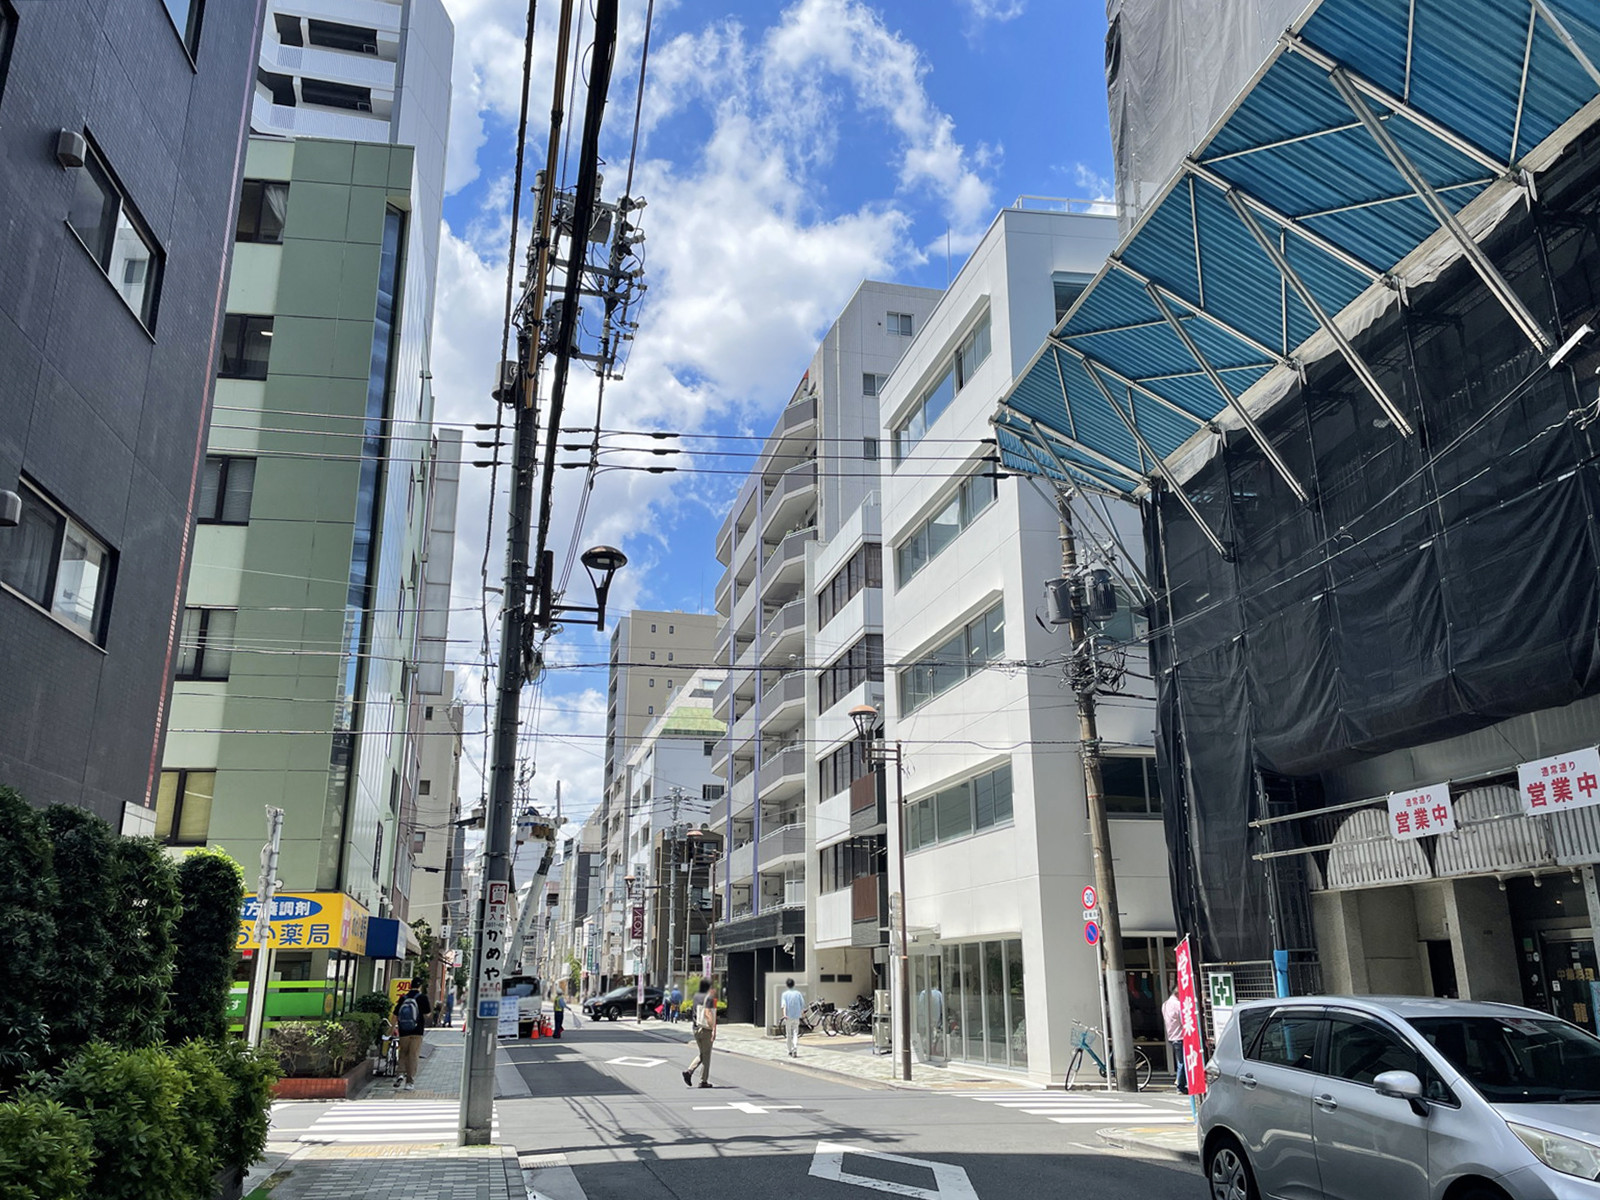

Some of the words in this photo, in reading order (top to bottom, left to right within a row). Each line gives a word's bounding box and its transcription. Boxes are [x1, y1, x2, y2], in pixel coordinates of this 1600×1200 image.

[1540, 761, 1576, 777] 通常通り
[1527, 772, 1599, 808] 営業中
[1396, 804, 1448, 834] 営業中
[1085, 892, 1093, 903] 30
[484, 930, 503, 980] かめや
[1177, 950, 1198, 1084] 営業中
